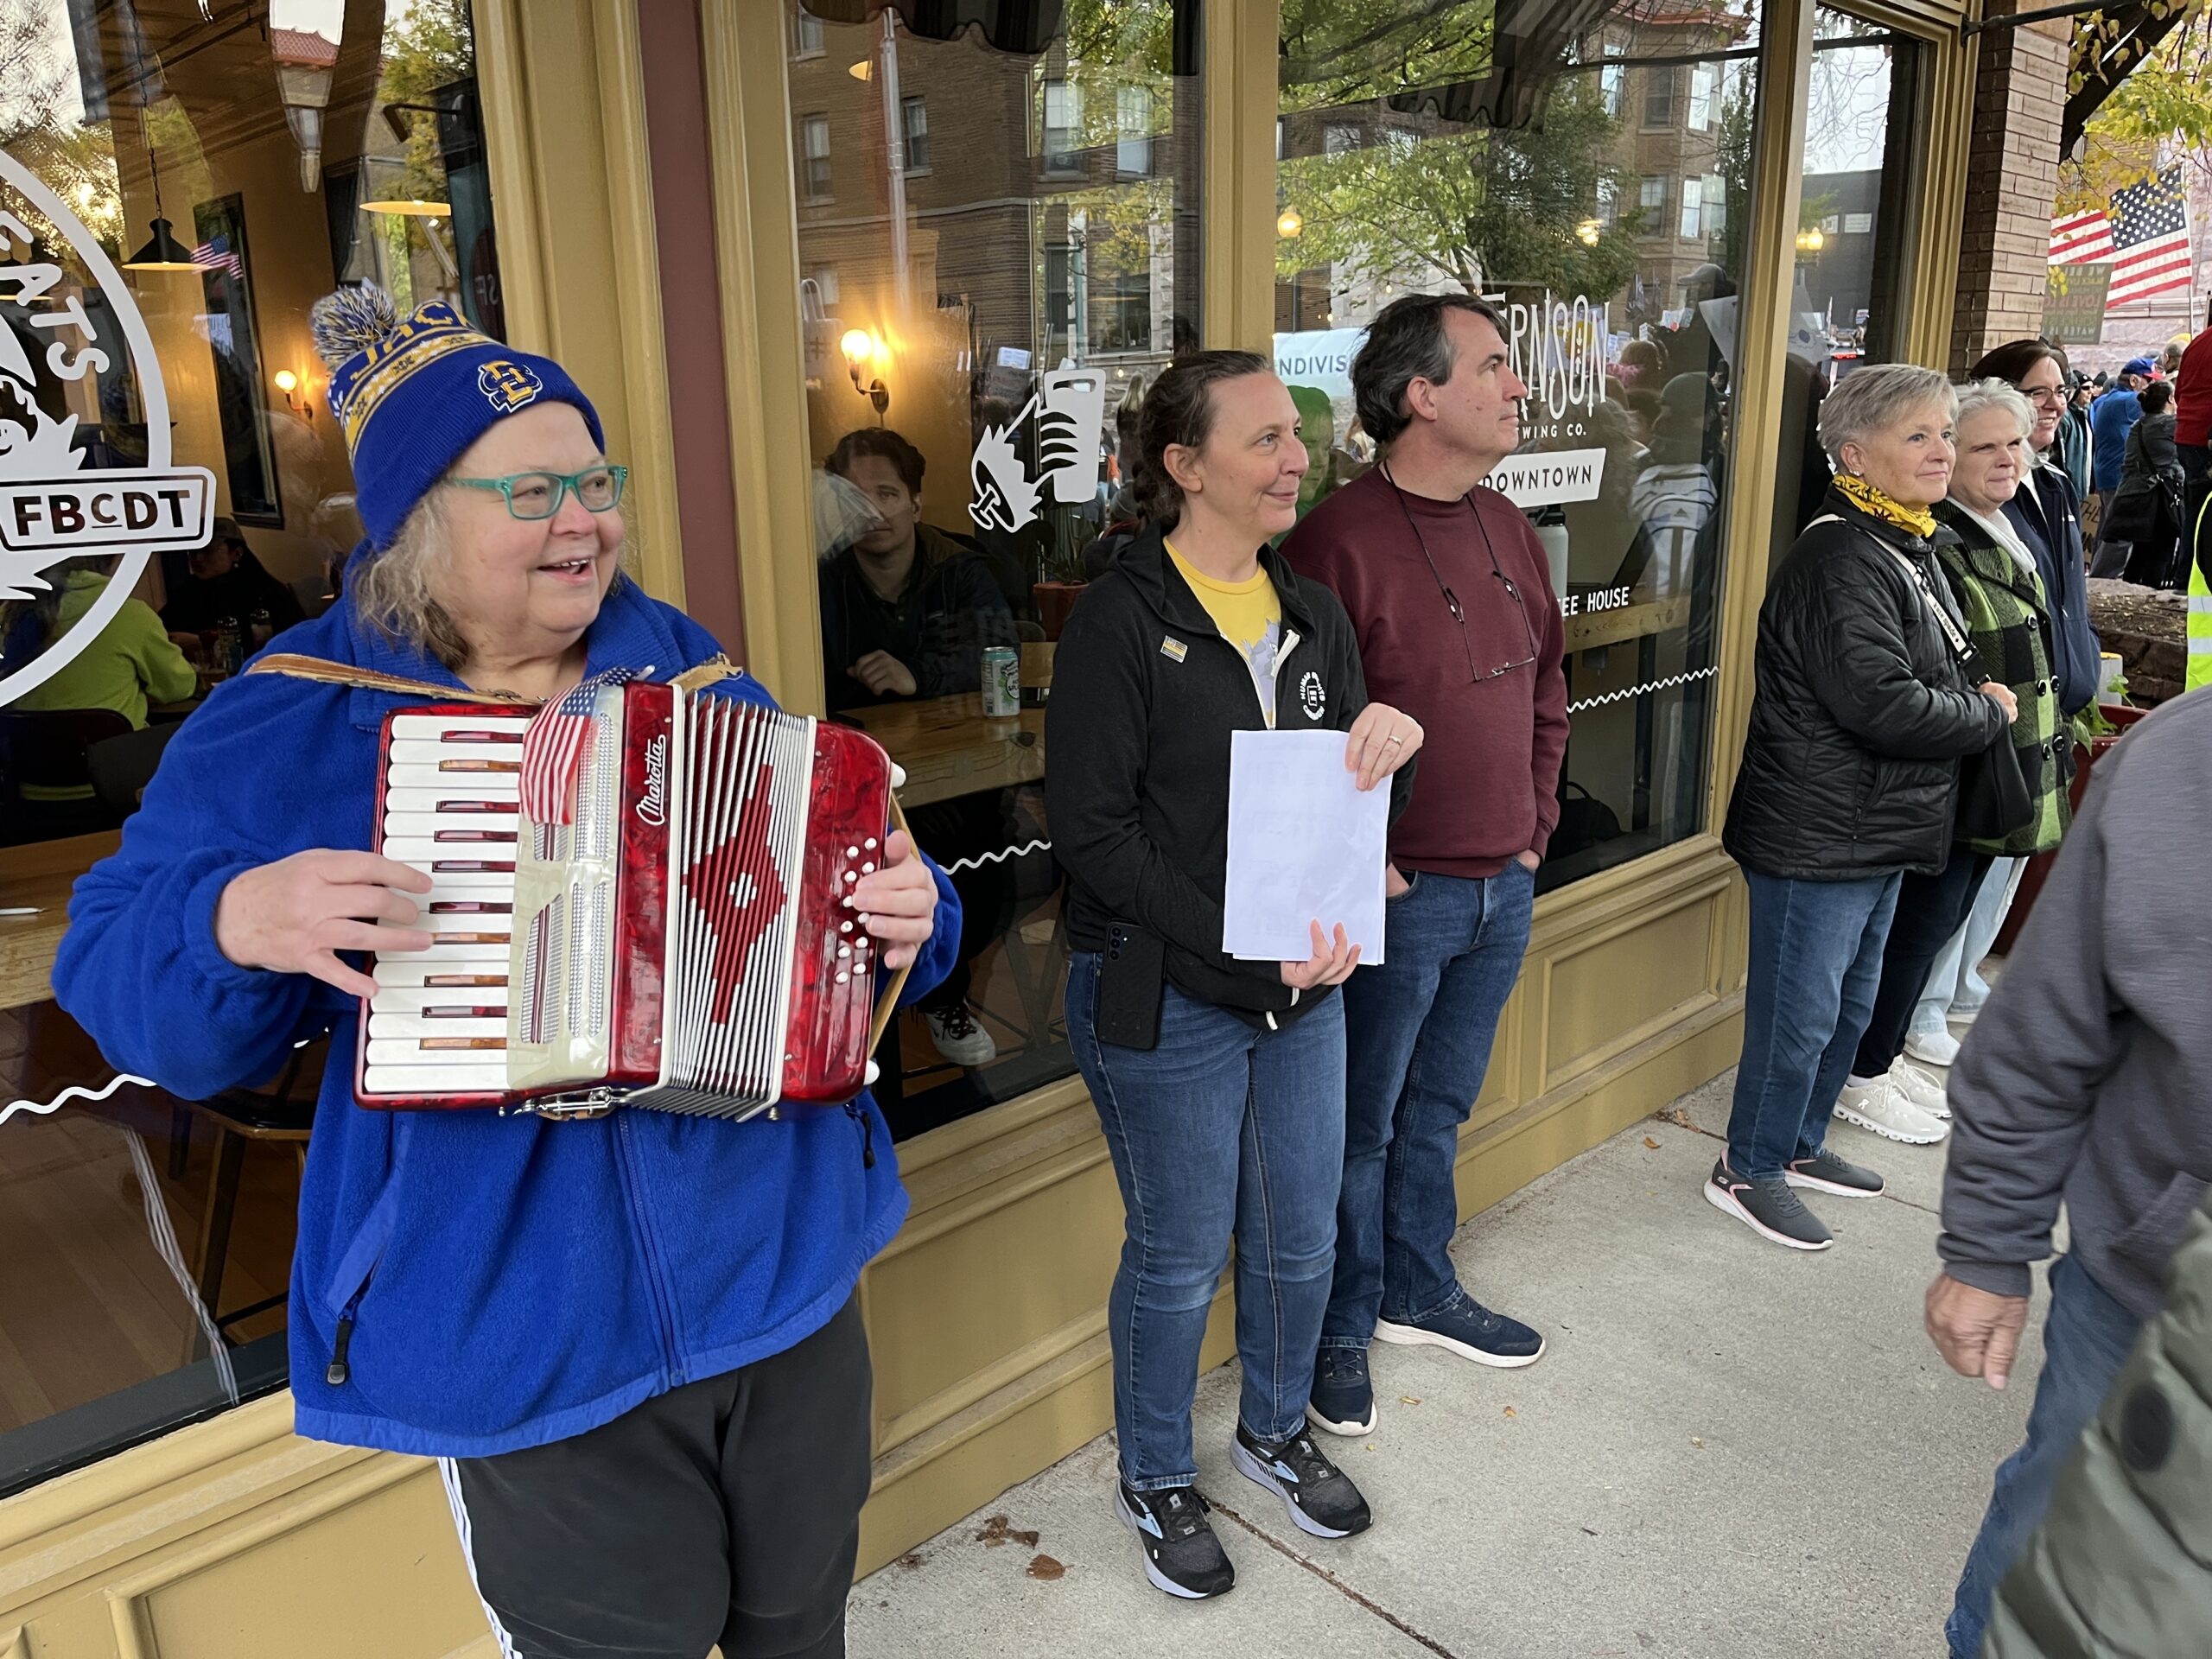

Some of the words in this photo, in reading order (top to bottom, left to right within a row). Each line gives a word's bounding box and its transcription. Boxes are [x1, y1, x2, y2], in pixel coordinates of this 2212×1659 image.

[1480, 288, 1610, 422] RNSON
[1516, 424, 1558, 440] WING
[1567, 423, 1587, 437] CO.
[1483, 465, 1592, 493] DOWNTOWN
[1557, 594, 1580, 617] EE
[1587, 586, 1630, 612] HOUSE
[636, 734, 666, 826] Marotta
